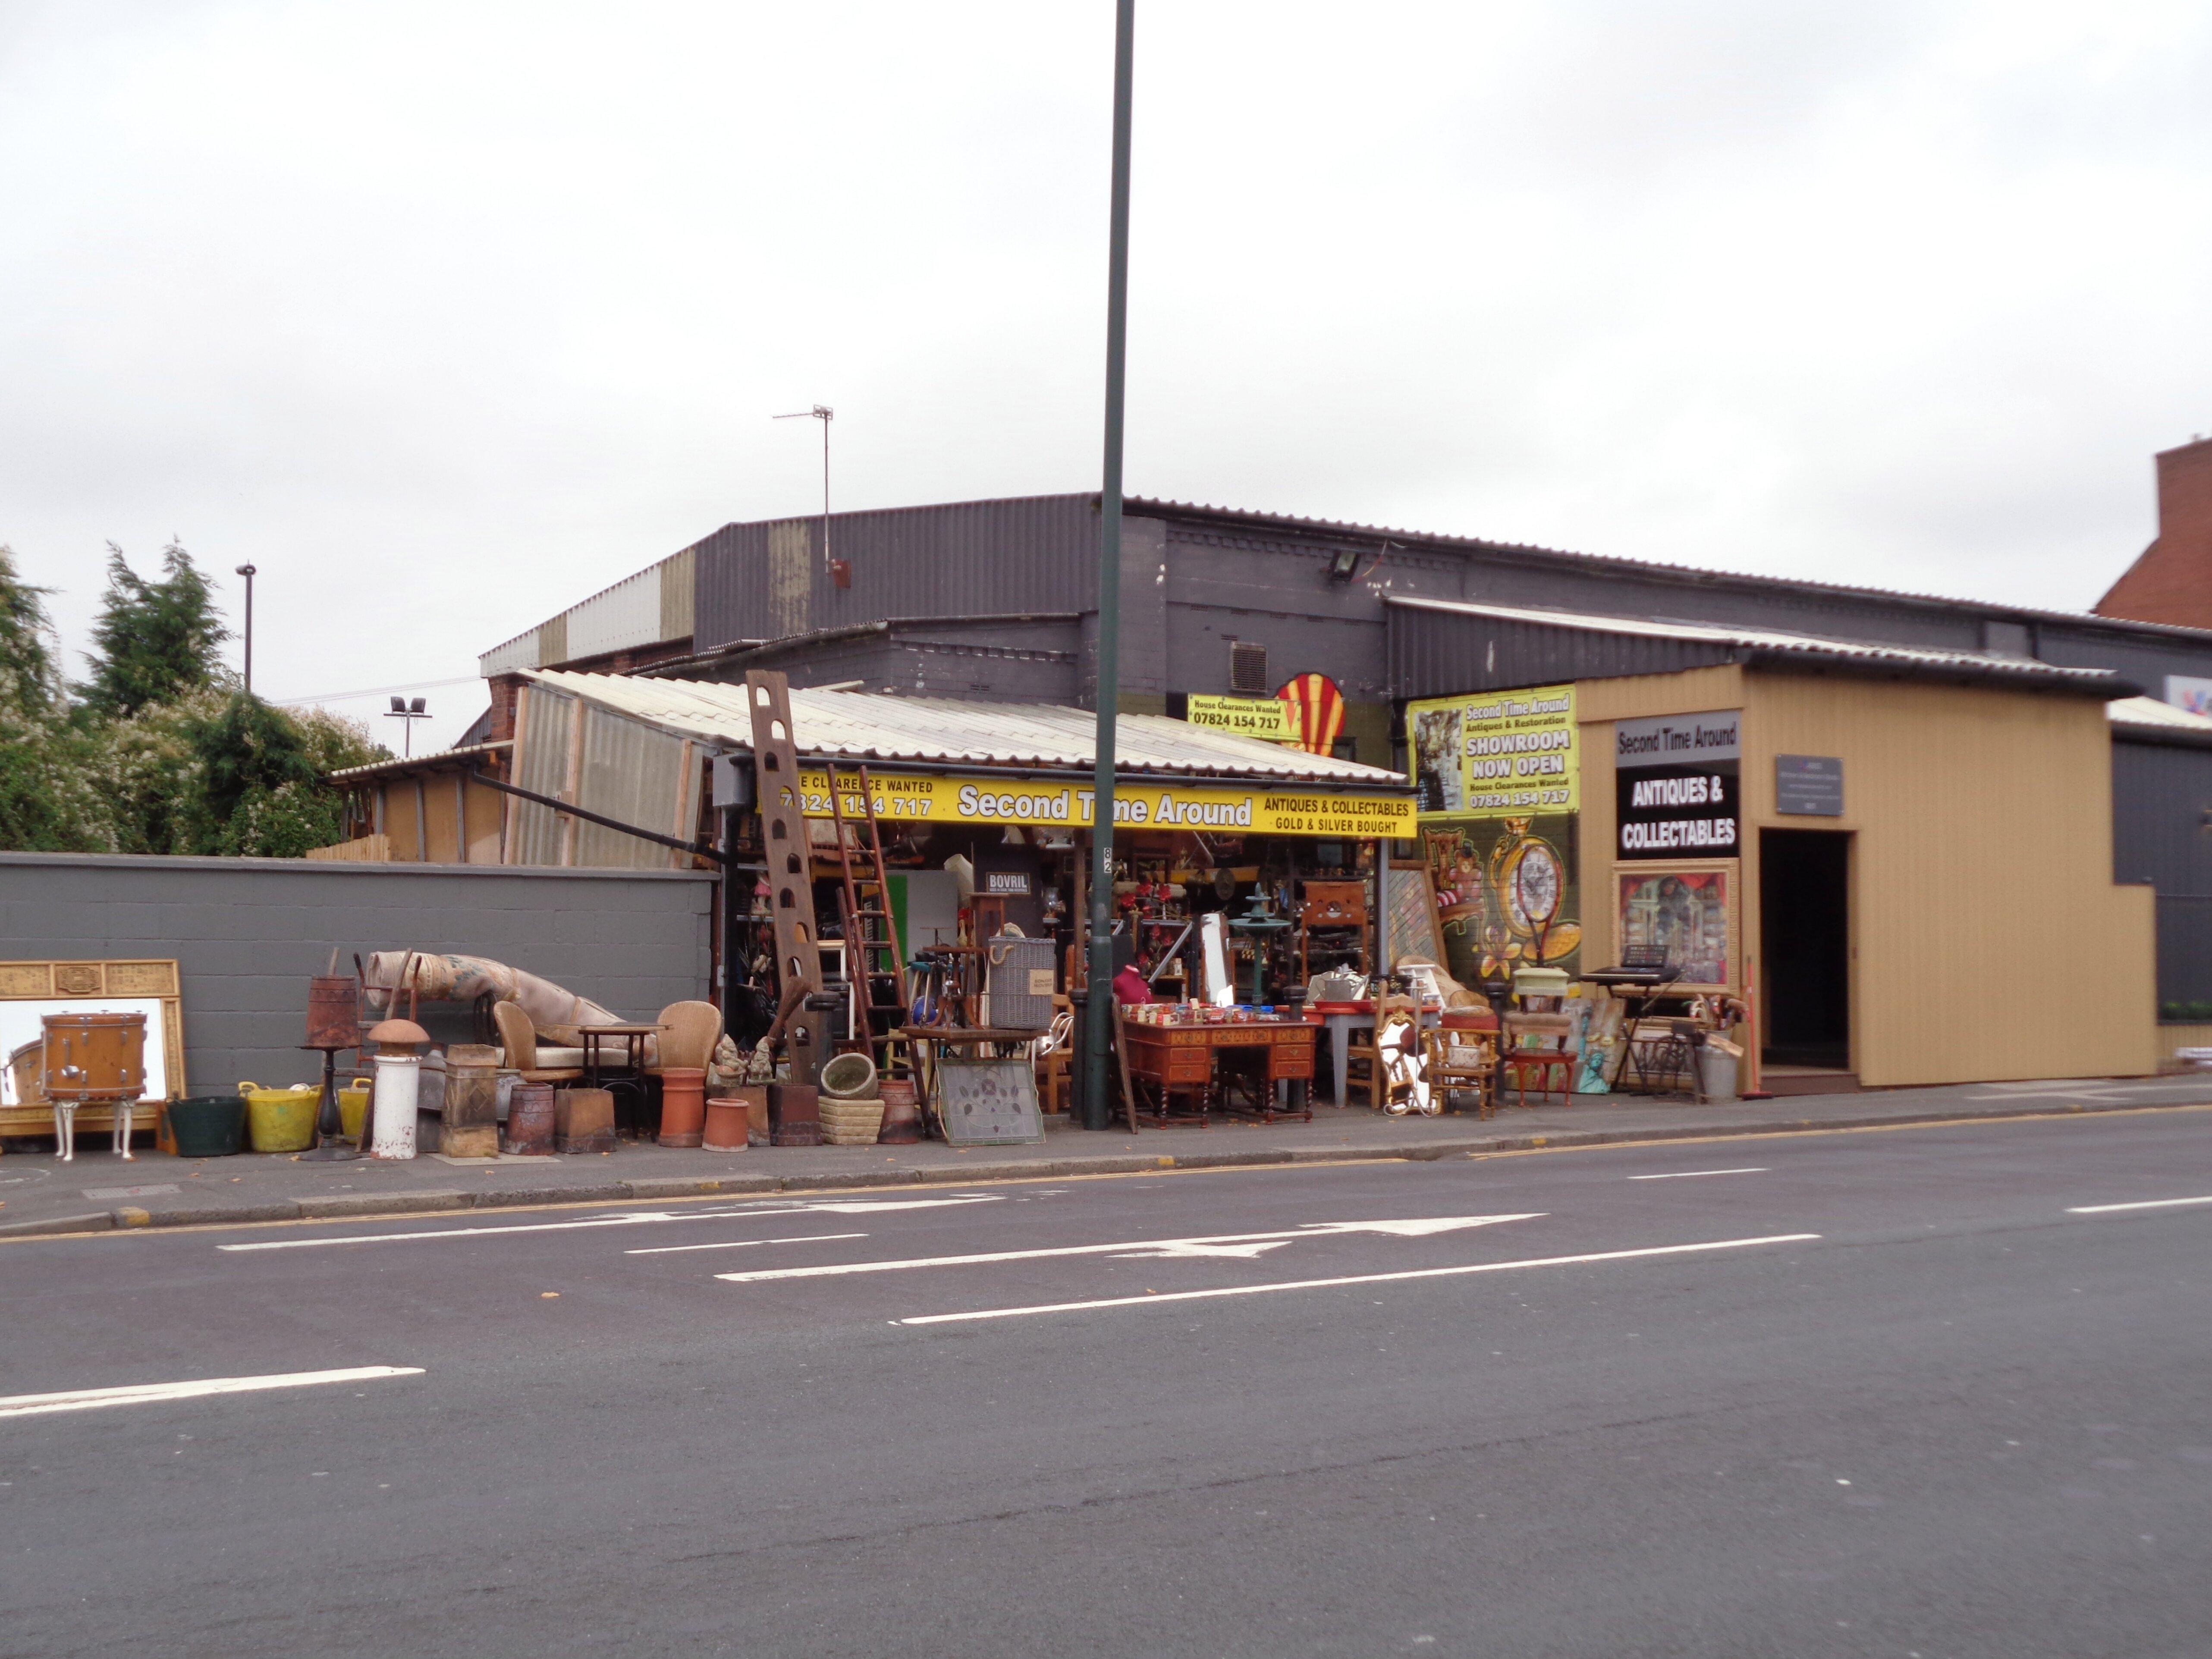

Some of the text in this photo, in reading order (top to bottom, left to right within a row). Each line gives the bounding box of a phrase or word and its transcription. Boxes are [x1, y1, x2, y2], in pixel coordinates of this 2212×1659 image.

[1195, 700, 1281, 714] House Clearances Wanted
[1467, 693, 1570, 720] Second Time Around
[1194, 712, 1280, 729] 07824 154 717
[1467, 722, 1502, 732] Antiques
[1515, 716, 1565, 727] Restoration
[1467, 729, 1570, 756] SHOWROOM
[1618, 721, 1737, 754] Second Time Around
[1473, 754, 1564, 779] NOW OPEN
[813, 777, 881, 790] CLARECE
[887, 780, 932, 792] WANTED
[1470, 778, 1568, 791] House Clearances Wanted
[1632, 776, 1723, 807] ANTIQUES &
[893, 798, 932, 816] 717
[958, 784, 1252, 826] Second Tme Around
[1264, 798, 1409, 817] ANTIQUES & COLLECTABLES
[1470, 789, 1569, 808] 07824 154 717
[1276, 817, 1398, 833] GOLD & SILVER BOUGHT
[1622, 818, 1735, 848] COLLECTABLES
[990, 874, 1027, 888] BOVRIL
